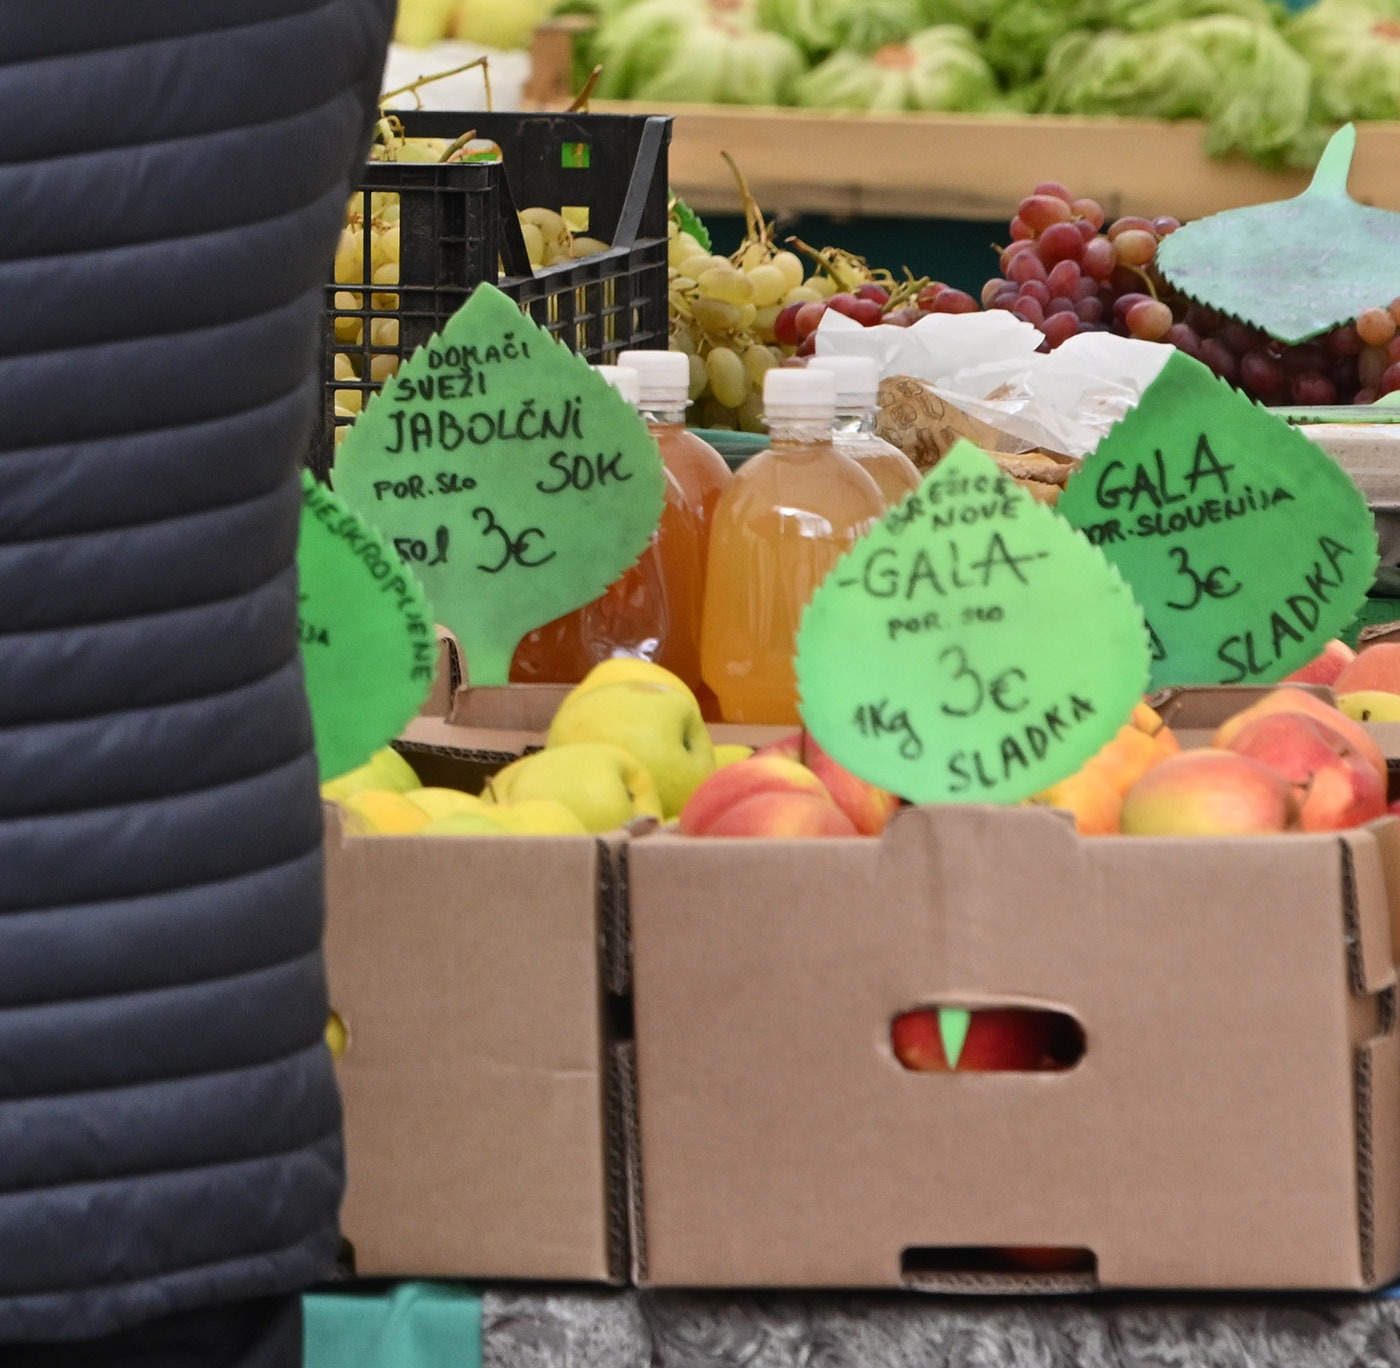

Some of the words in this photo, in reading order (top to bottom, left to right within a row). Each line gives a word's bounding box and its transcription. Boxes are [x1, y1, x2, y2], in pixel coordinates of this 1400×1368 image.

[428, 332, 531, 370] DOMAČI
[394, 368, 487, 402] SVEŽI
[536, 451, 634, 494] SOK
[1096, 432, 1236, 512] GALA
[471, 507, 558, 574] 3€
[930, 494, 1026, 532] NOVE
[1165, 545, 1243, 612] 3€
[1217, 534, 1354, 686] SLADKA
[937, 644, 1031, 719] 3€
[948, 694, 1098, 794] SLADKA
